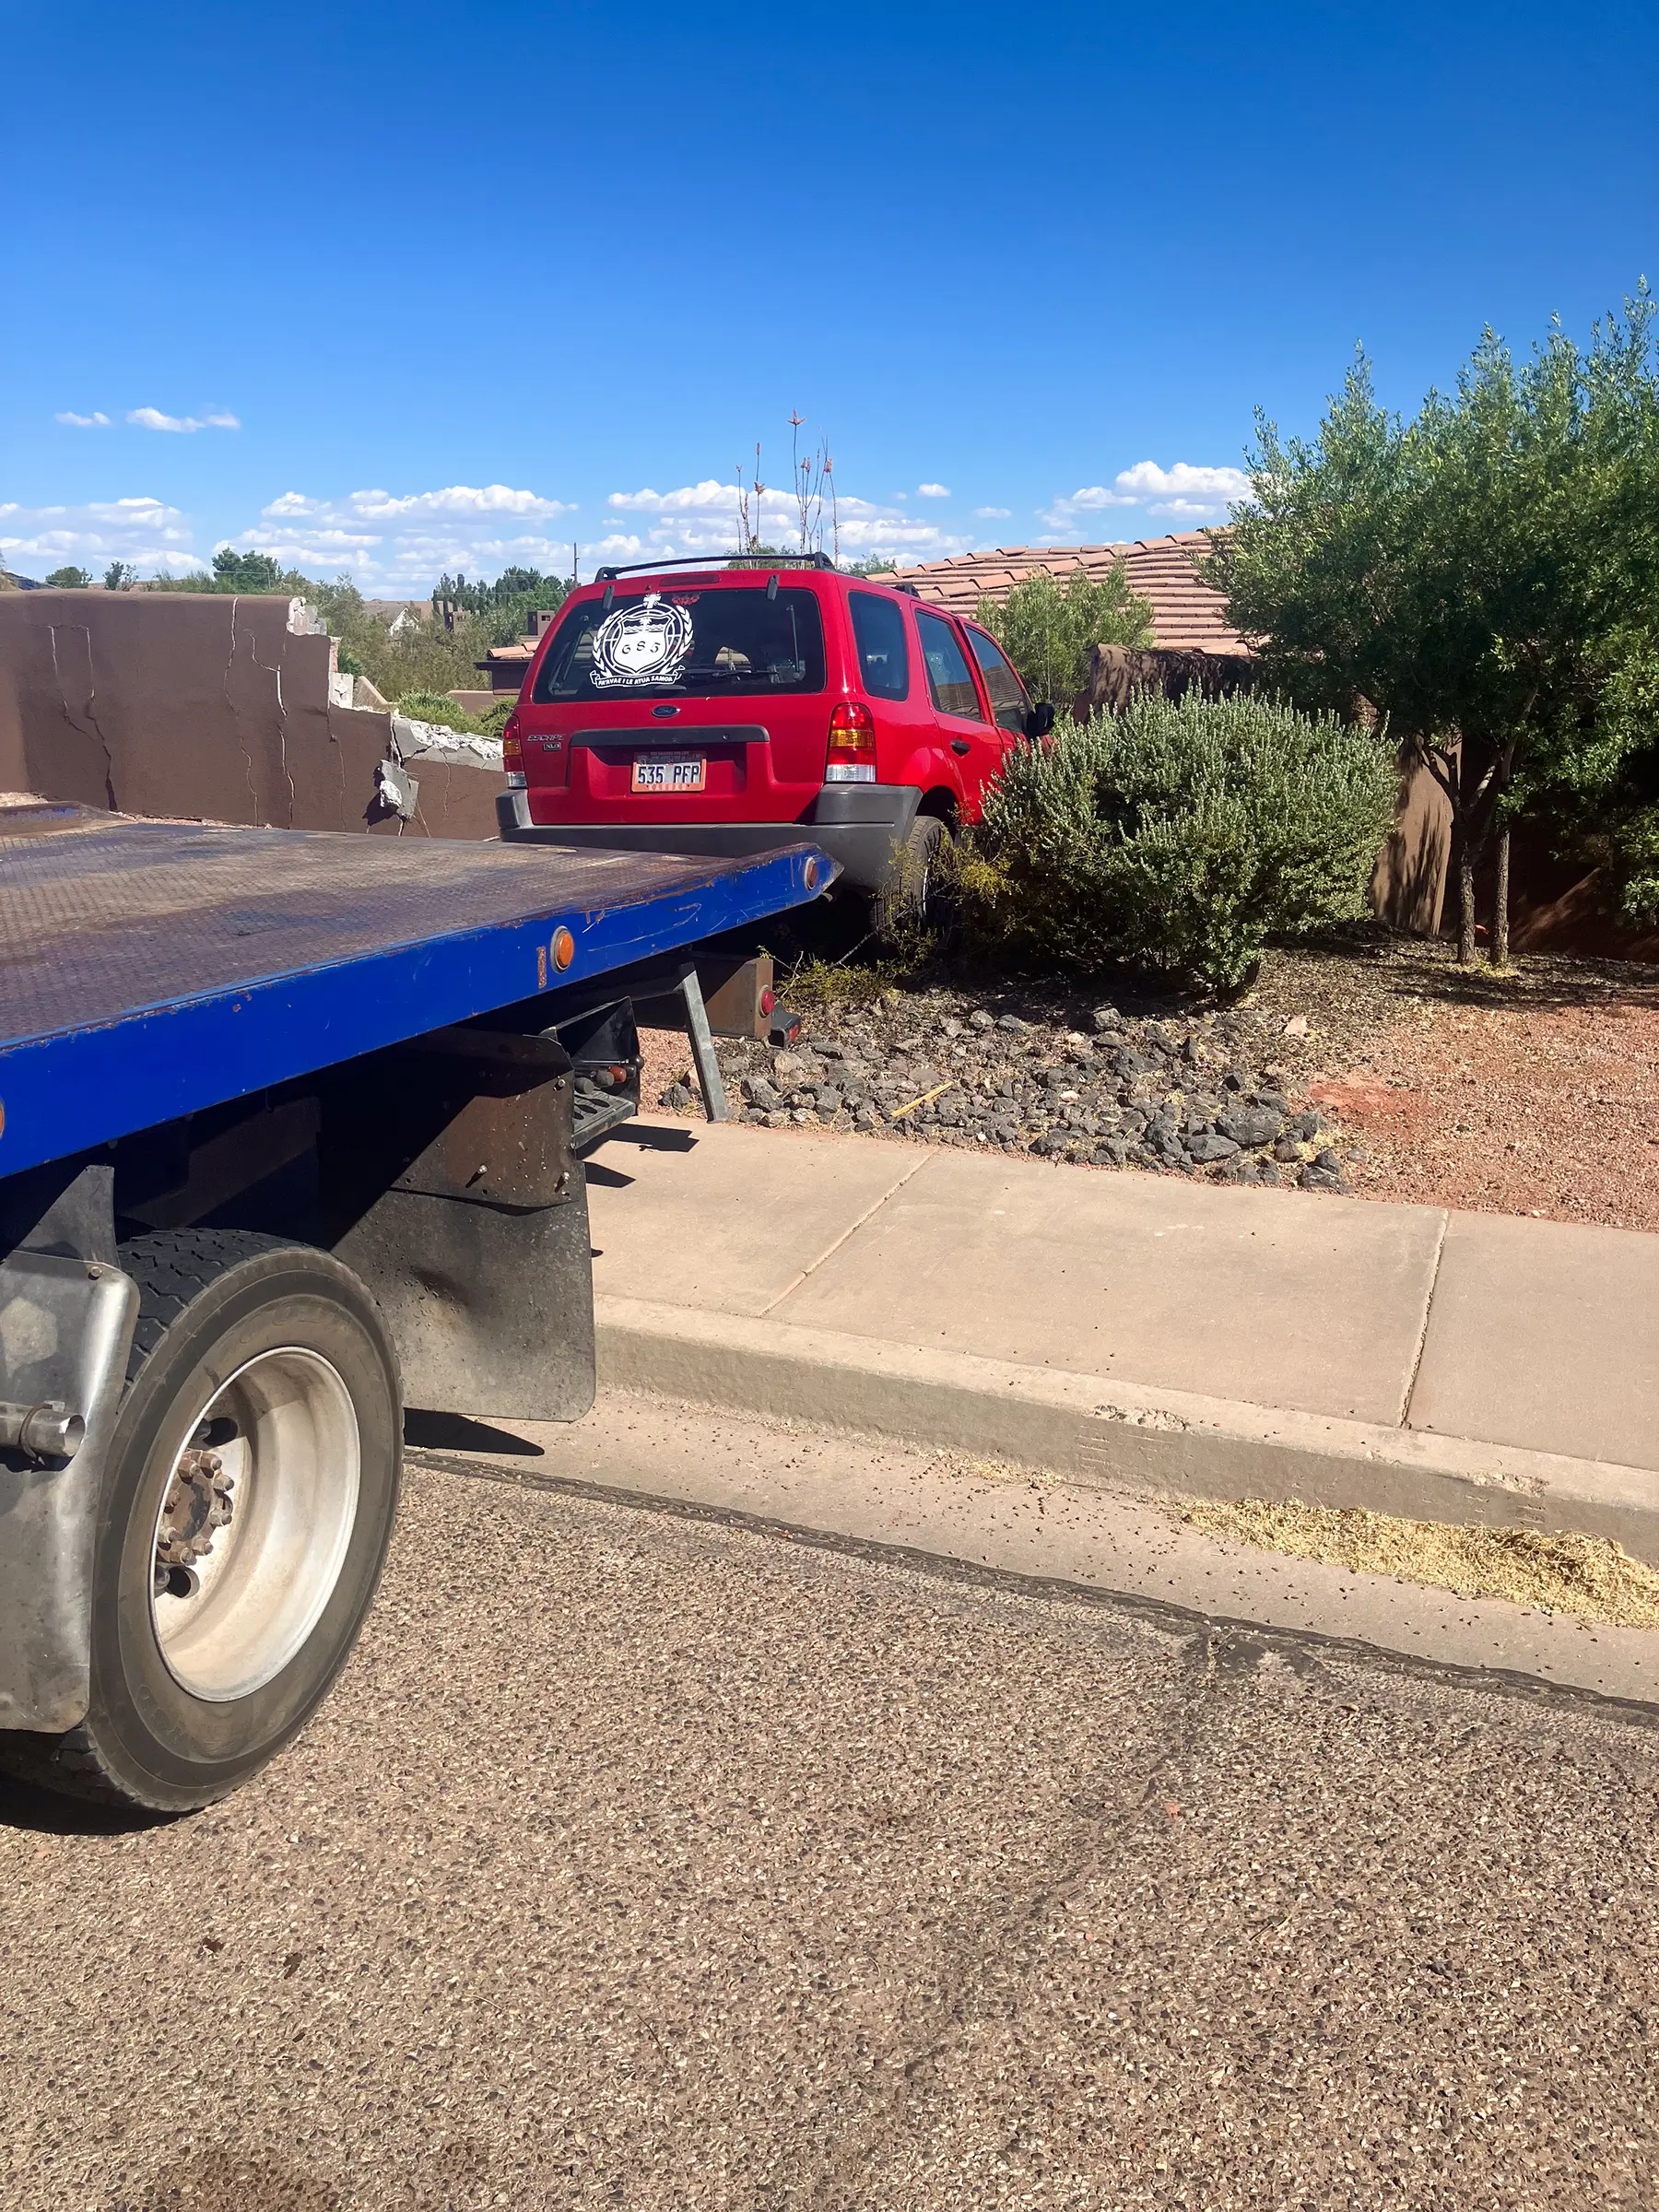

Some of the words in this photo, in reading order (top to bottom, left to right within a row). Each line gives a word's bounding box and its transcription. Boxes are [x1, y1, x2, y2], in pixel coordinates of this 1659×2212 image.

[621, 641, 661, 654] 685
[527, 734, 566, 742] ESCAPE
[638, 766, 665, 783] 535
[674, 765, 700, 783] PFP
